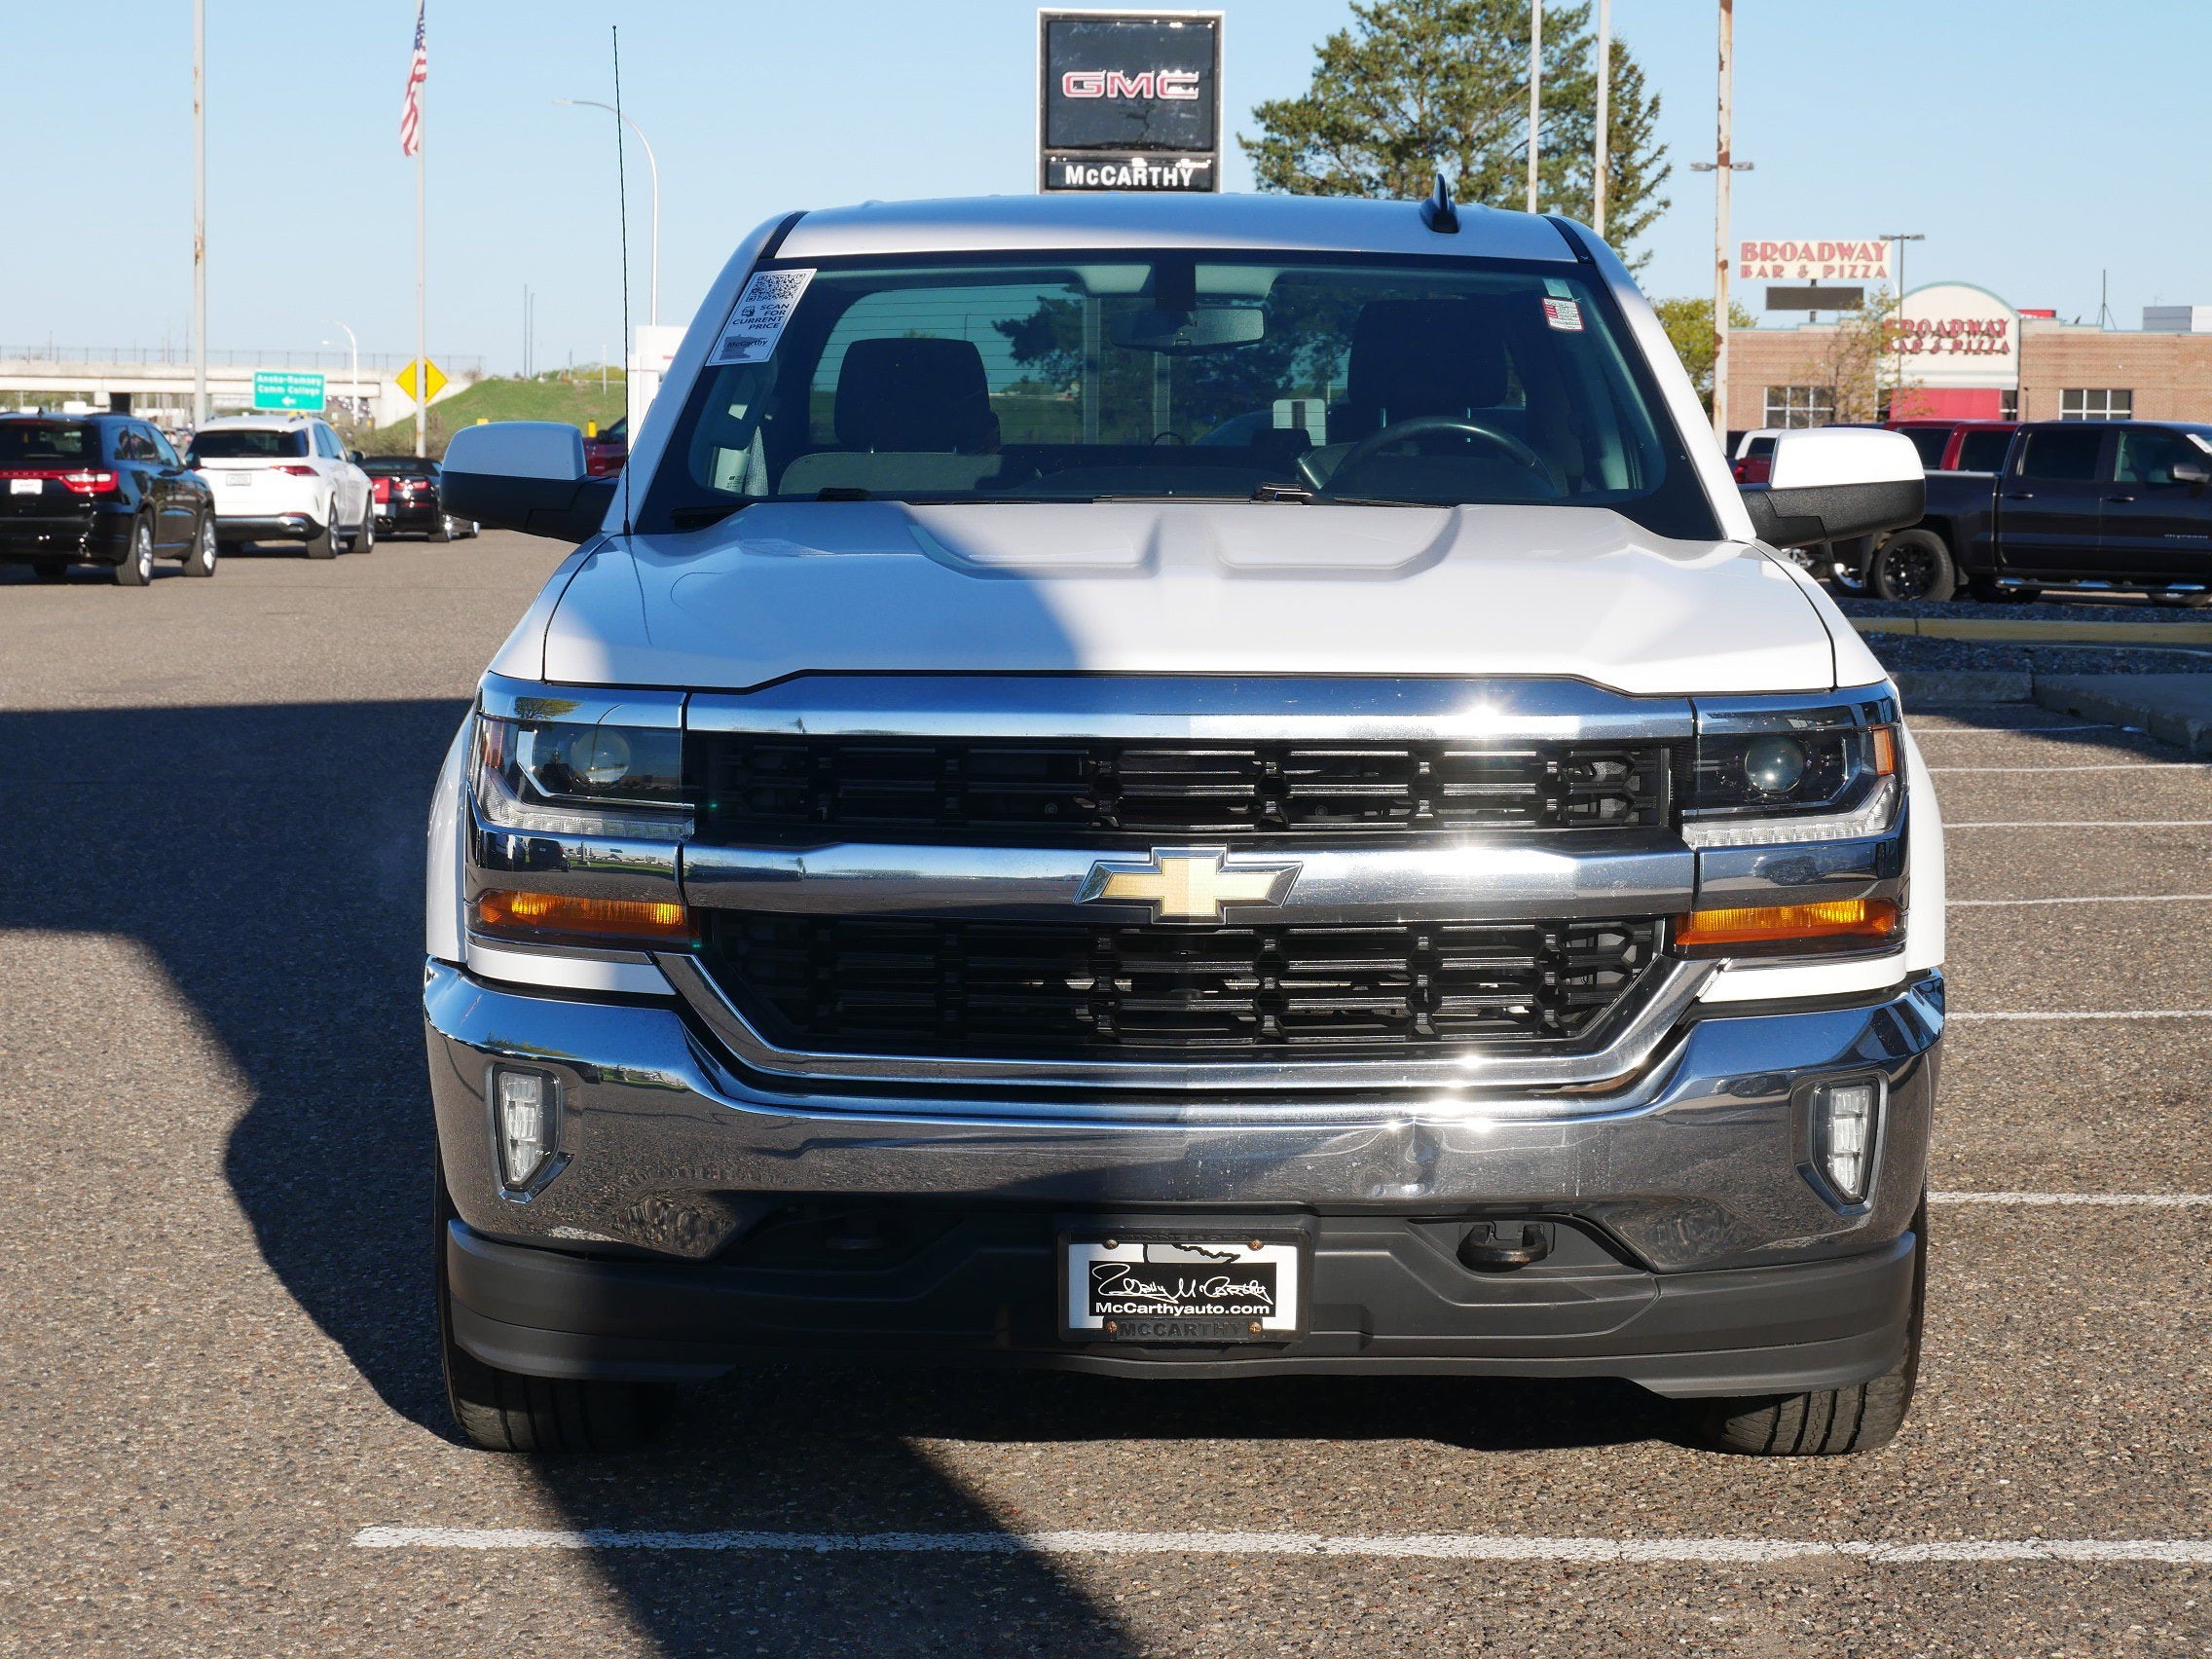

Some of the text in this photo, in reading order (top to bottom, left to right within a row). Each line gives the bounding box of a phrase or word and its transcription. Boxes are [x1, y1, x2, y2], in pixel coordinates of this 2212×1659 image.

[1062, 70, 1199, 100] GMC
[1065, 165, 1194, 187] McCARTHY
[1741, 241, 1888, 262] BROADWAY
[1741, 264, 1887, 278] BAR & PIZZA
[732, 316, 785, 325] CURRENT
[1883, 318, 2009, 339] BROADWAY
[1949, 339, 2009, 355] PIZZA
[1095, 1302, 1270, 1316] McCarthyauto.com
